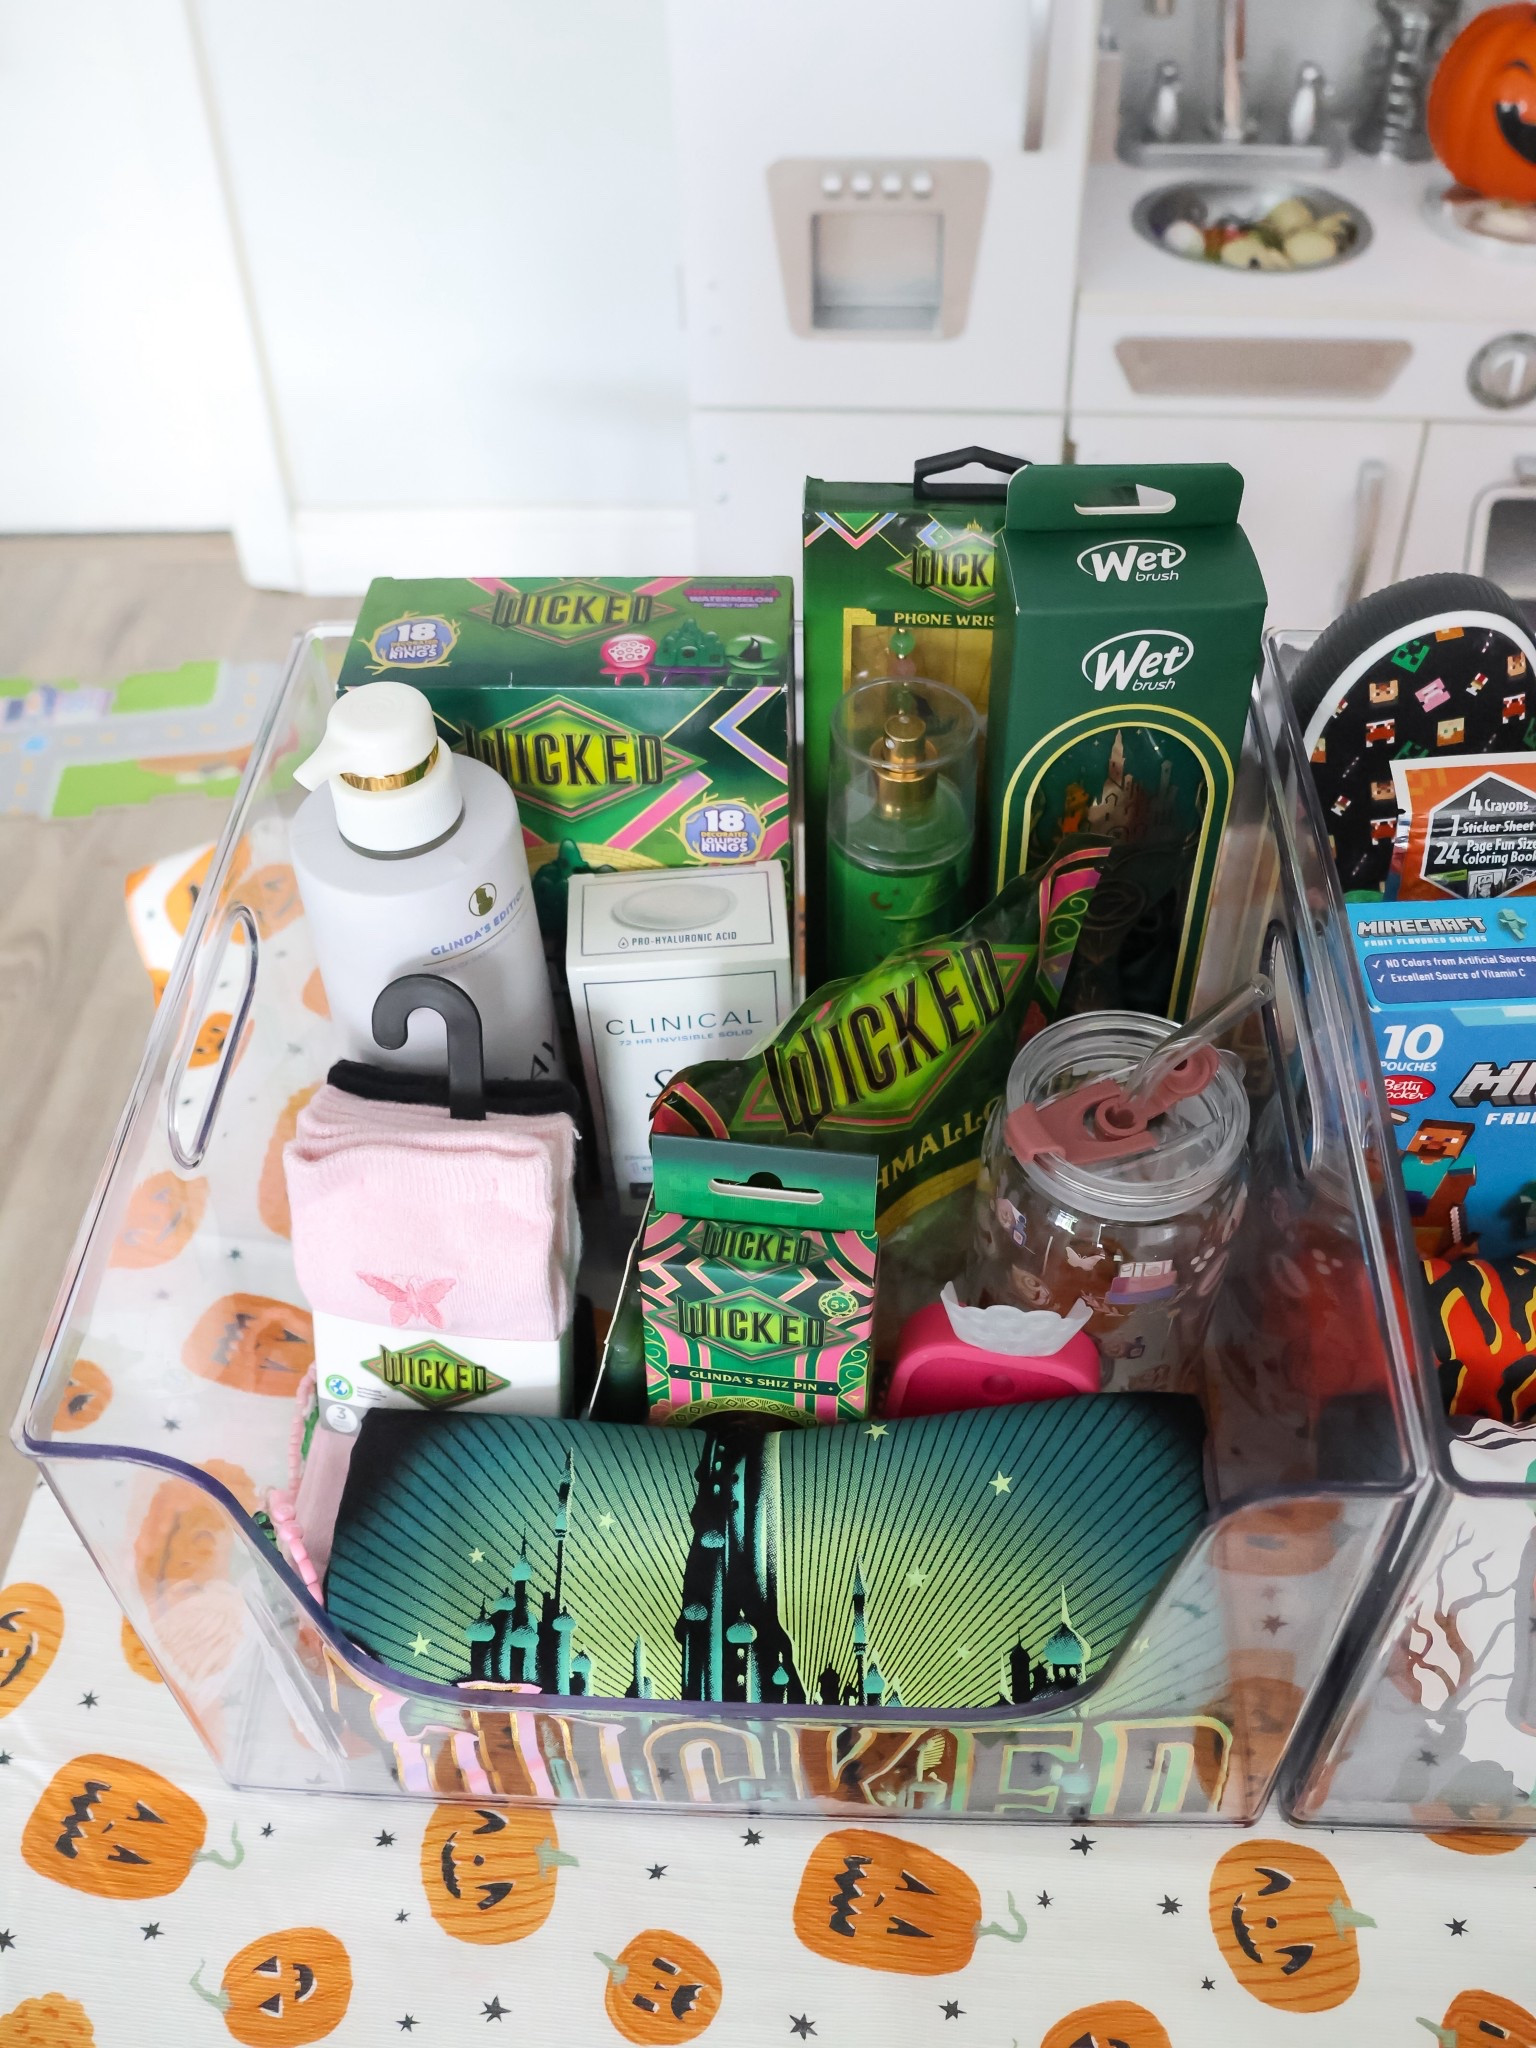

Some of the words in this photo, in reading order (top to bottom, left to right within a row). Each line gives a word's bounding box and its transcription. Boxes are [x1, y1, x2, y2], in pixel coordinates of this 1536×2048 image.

[910, 545, 993, 591] WICK
[1090, 545, 1177, 582] Wet
[1135, 570, 1180, 582] brush
[491, 588, 653, 629] WICKED
[894, 612, 952, 625] PHONE
[956, 614, 994, 627] WRIS
[397, 622, 437, 642] 18
[388, 648, 438, 660] RINGS
[1093, 640, 1184, 691] Wet
[1132, 677, 1176, 691] brush
[461, 720, 665, 786] WICKED
[1468, 791, 1483, 816] 4
[1484, 798, 1529, 814] Crayons
[704, 809, 746, 832] 18
[1450, 814, 1461, 837] 1
[1462, 821, 1500, 834] Sticker
[1503, 820, 1535, 832] Sheet
[700, 837, 748, 846] LOLLIPOP
[700, 843, 749, 853] RINGS
[1466, 839, 1493, 854] Page
[1494, 838, 1515, 851] Fun
[1516, 837, 1536, 850] Size
[1433, 841, 1461, 865] 24
[1462, 852, 1509, 867] Coloring
[1356, 917, 1488, 938] MINECRAFT
[430, 922, 492, 956] GLINDA'S
[631, 931, 713, 946] PRO-HYALURONIC
[715, 931, 738, 941] ACID
[1385, 959, 1400, 968] NO
[1401, 957, 1432, 968] Colors
[1433, 956, 1457, 966] from
[1458, 954, 1498, 965] Artificial
[1498, 954, 1536, 964] Sources
[1390, 972, 1435, 983] Excellent
[1436, 970, 1469, 981] Source
[1470, 969, 1480, 979] of
[1481, 968, 1518, 978] Vitamin
[1519, 968, 1526, 977] C
[605, 1009, 763, 1035] CLINICAL
[656, 1032, 715, 1044] INVISIBLE
[718, 1029, 753, 1038] SOLID
[762, 938, 1007, 1139] WICKED
[1383, 1023, 1444, 1060] 10
[1380, 1060, 1438, 1072] POUCHES
[1384, 1078, 1423, 1093] Betty
[1386, 1089, 1428, 1100] ocker
[1485, 1111, 1536, 1126] FRUI
[701, 1222, 812, 1266] WICKED
[830, 1300, 847, 1310] 5+
[676, 1293, 826, 1348] WICKED
[379, 1343, 488, 1394] WICKED
[689, 1370, 754, 1386] GLINDA'S
[757, 1378, 789, 1389] SHIZ
[793, 1382, 818, 1392] PIN
[335, 1406, 347, 1420] 3
